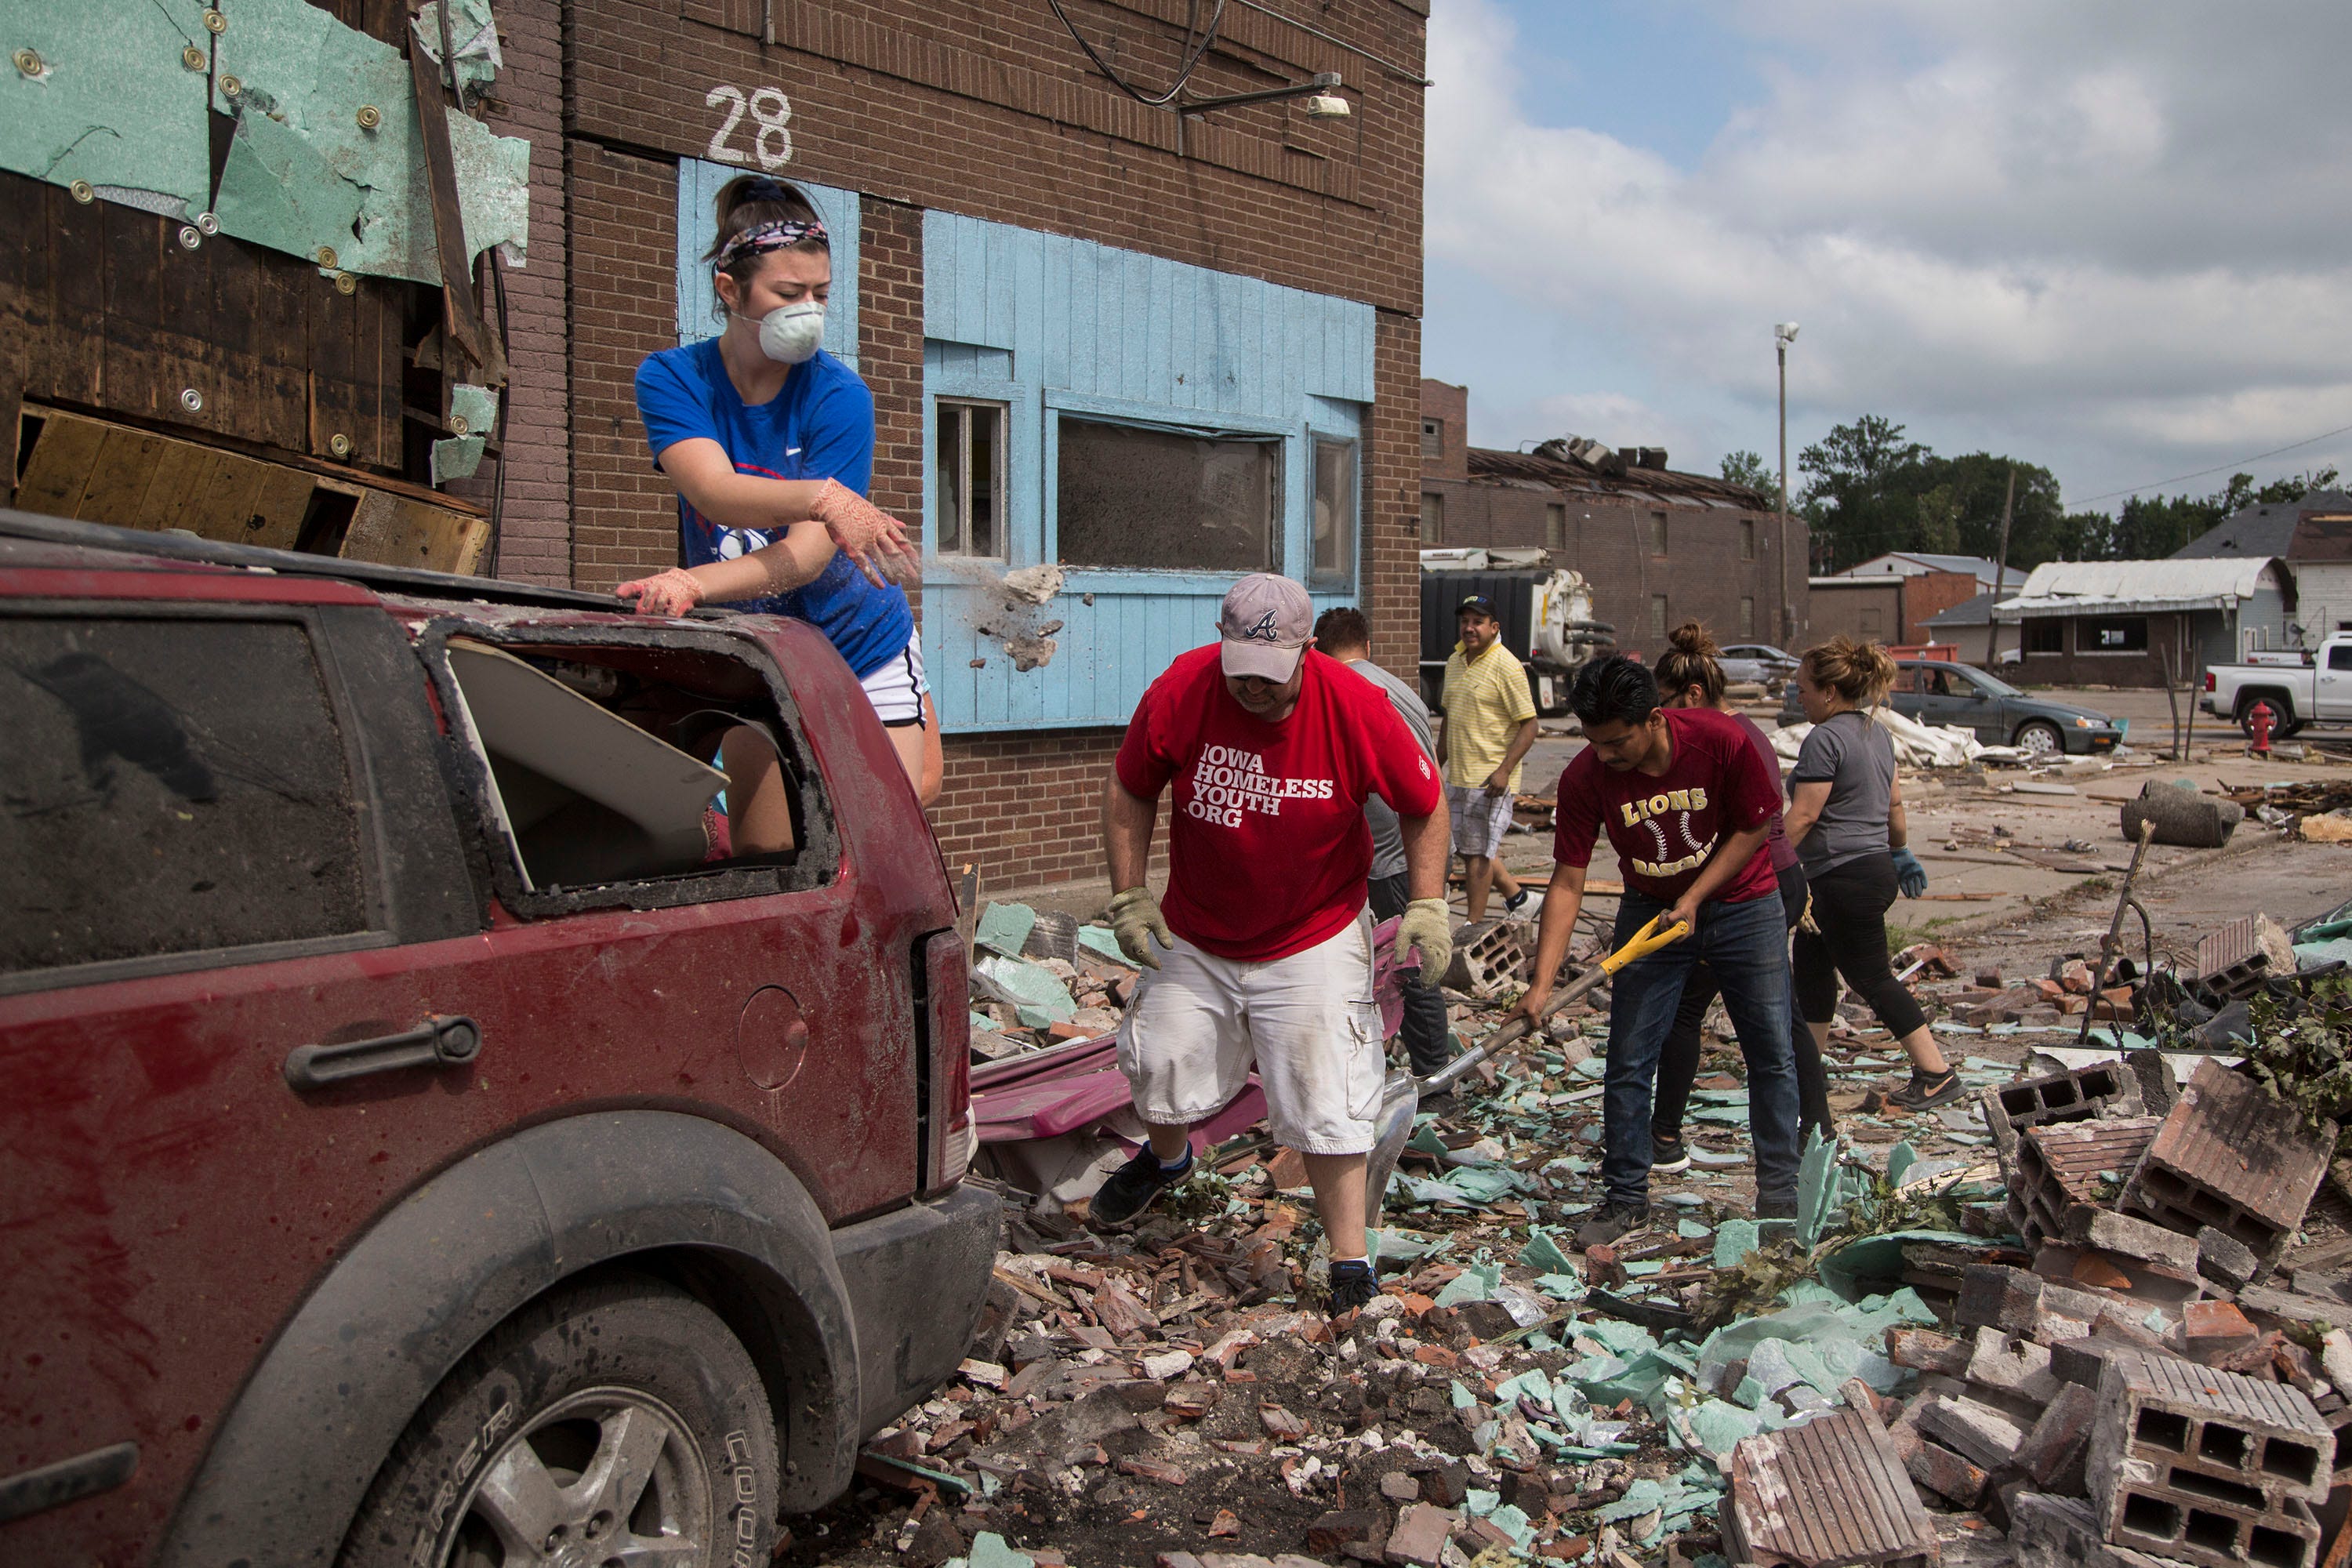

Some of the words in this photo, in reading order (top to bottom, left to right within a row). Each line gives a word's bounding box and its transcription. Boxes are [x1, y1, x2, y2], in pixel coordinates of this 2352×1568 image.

[706, 85, 793, 171] 28
[1246, 609, 1278, 641] A
[1200, 743, 1265, 774] IOWA
[1194, 762, 1334, 799] HOMELESS
[1182, 800, 1243, 828] .ORG
[1192, 781, 1281, 816] YOUTH
[1621, 788, 1708, 828] LIONS
